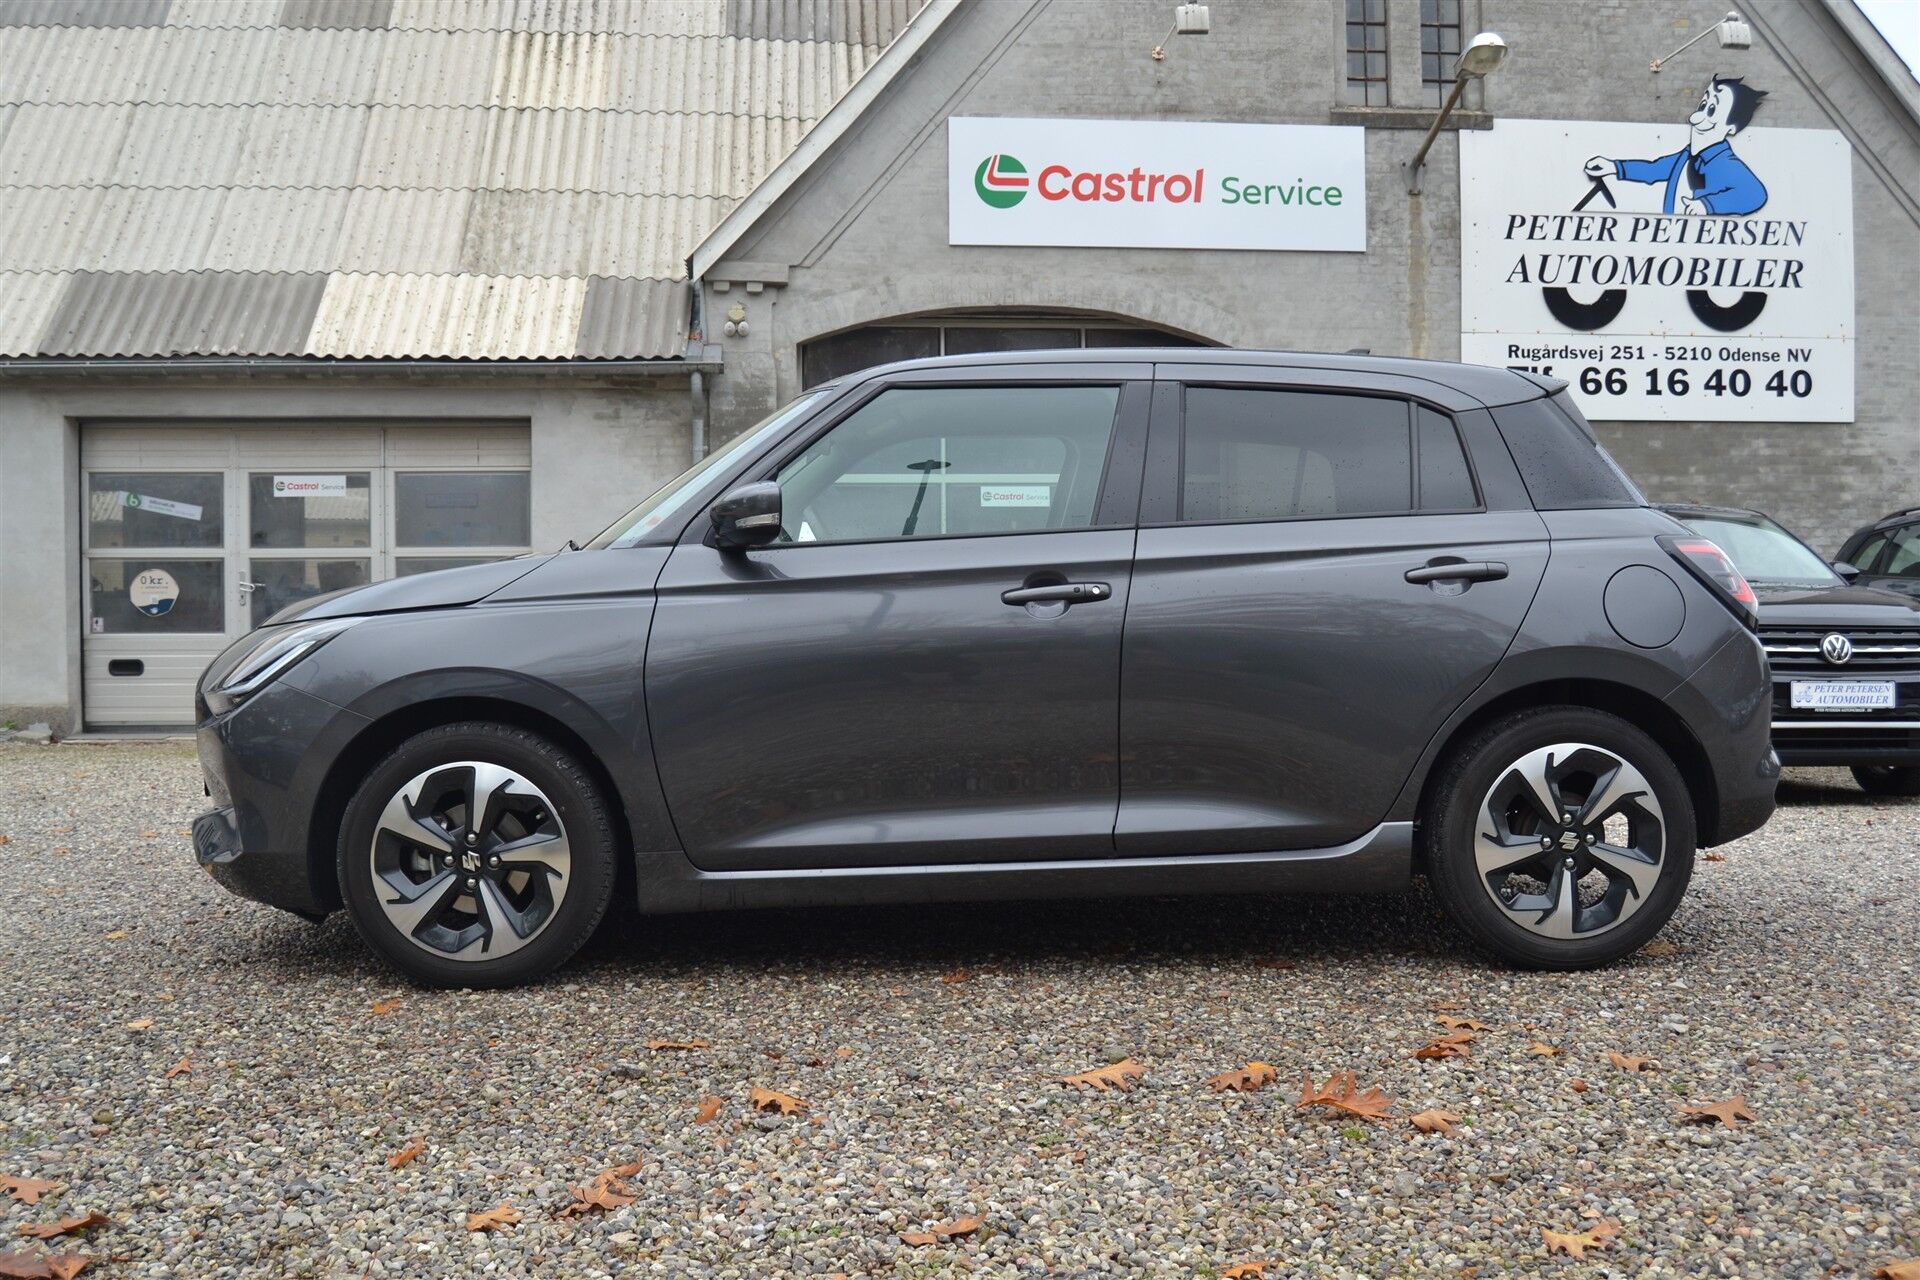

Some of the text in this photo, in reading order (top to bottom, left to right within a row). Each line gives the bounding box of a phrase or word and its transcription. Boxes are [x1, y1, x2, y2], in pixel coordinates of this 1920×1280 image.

[1037, 164, 1343, 207] Castrol Service
[1504, 214, 1808, 247] PETER PETERSEN
[1505, 253, 1805, 288] AUTOMOBILER
[1507, 343, 1604, 363] Rugårdsvej
[1610, 345, 1646, 360] 251
[1664, 346, 1712, 361] 5210
[1718, 346, 1781, 363] Odense
[1787, 348, 1813, 363] NV
[1579, 366, 1813, 398] 66 16 40 40
[287, 482, 319, 490] Castrol
[993, 492, 1024, 501] Castrol
[1814, 685, 1891, 693] PETER PETERSEN
[1816, 695, 1888, 704] AUTOMOBILER
